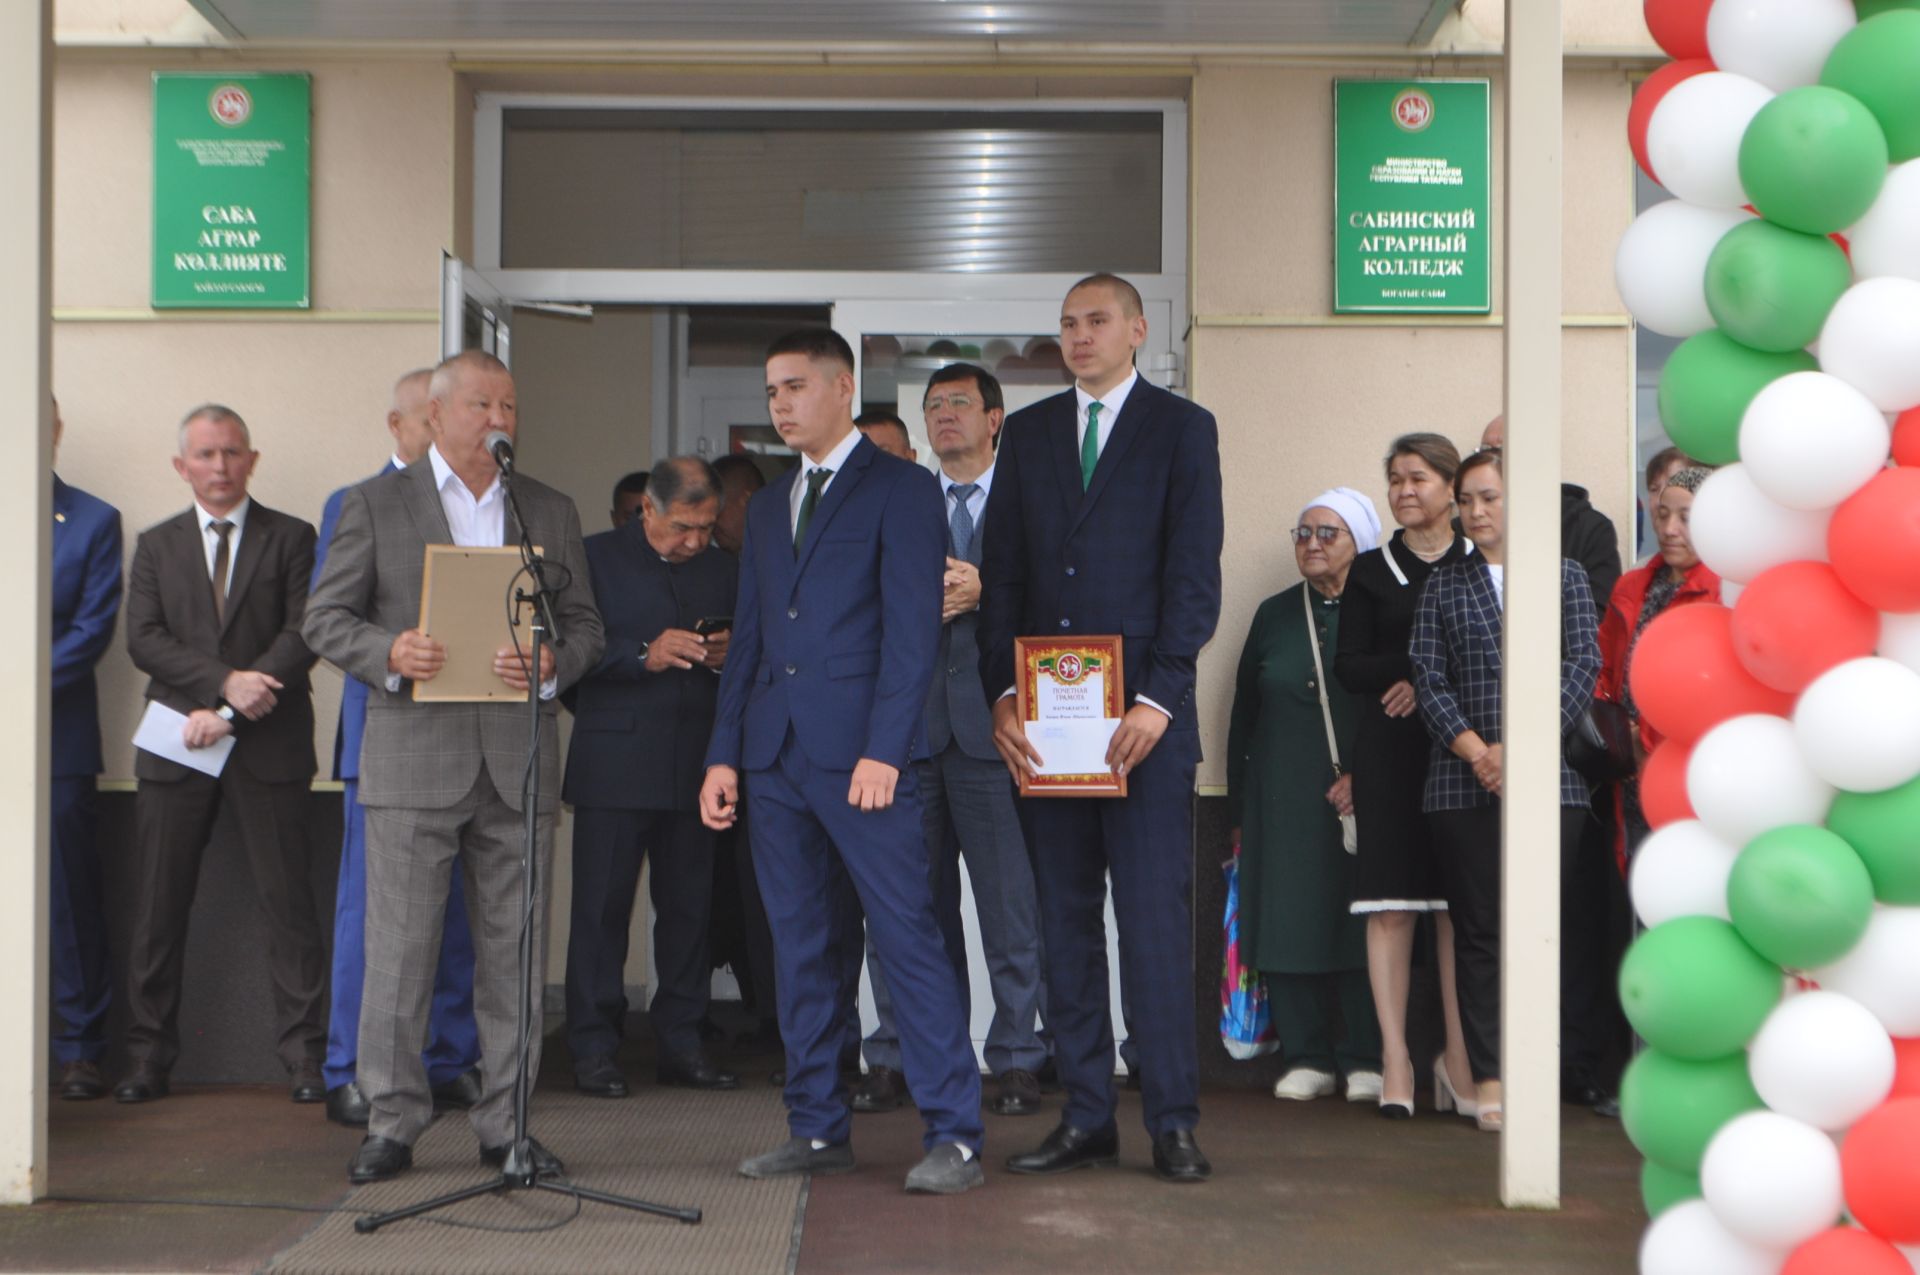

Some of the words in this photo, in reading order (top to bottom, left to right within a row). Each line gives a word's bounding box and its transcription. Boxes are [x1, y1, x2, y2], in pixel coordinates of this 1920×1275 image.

[1421, 176, 1463, 186] ТАТАРСТАН
[202, 205, 257, 224] САБА
[1349, 208, 1475, 229] САБИНСКИЙ
[198, 229, 261, 248] АГРАР
[1359, 232, 1466, 253] АГРАРНЫЙ
[1363, 259, 1464, 279] КОЛЛЕДЖ
[1382, 289, 1419, 299] БОГАТЫЕ
[1421, 289, 1446, 299] САБЫ
